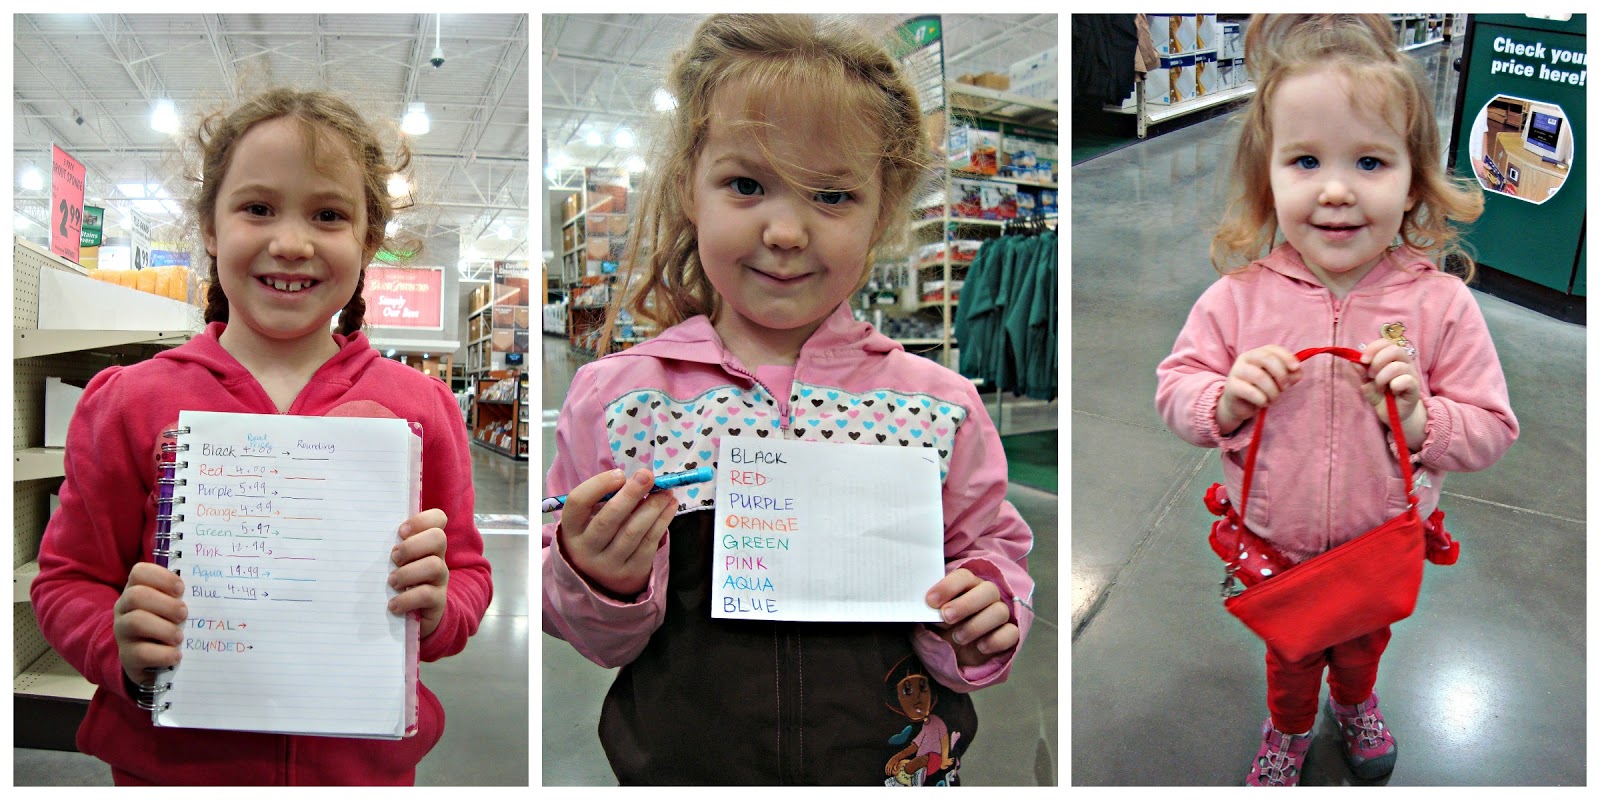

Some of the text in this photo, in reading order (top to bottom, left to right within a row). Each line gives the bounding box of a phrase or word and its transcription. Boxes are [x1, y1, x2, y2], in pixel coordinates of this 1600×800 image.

[1493, 36, 1546, 59] Check
[1491, 59, 1587, 86] price here!
[67, 172, 82, 191] SPONGE
[202, 443, 237, 458] Black
[297, 439, 335, 453] Rounding
[731, 447, 787, 464] BLACK
[199, 463, 266, 477] Red 4.00
[730, 469, 767, 486] RED
[198, 483, 233, 499] Purple
[729, 492, 794, 510] PURPLE
[197, 500, 272, 522] Orange 4.99
[195, 523, 232, 537] Green
[725, 514, 799, 532] ORANGE
[195, 543, 222, 558] Pink
[722, 534, 789, 551] GREEN
[725, 555, 768, 571] PINK
[192, 564, 222, 582] Aqua
[722, 574, 775, 592] AQUA
[191, 585, 221, 599] Blue
[723, 596, 778, 613] BLUE
[186, 618, 236, 631] TOTAL
[186, 638, 246, 653] ROUNDED
